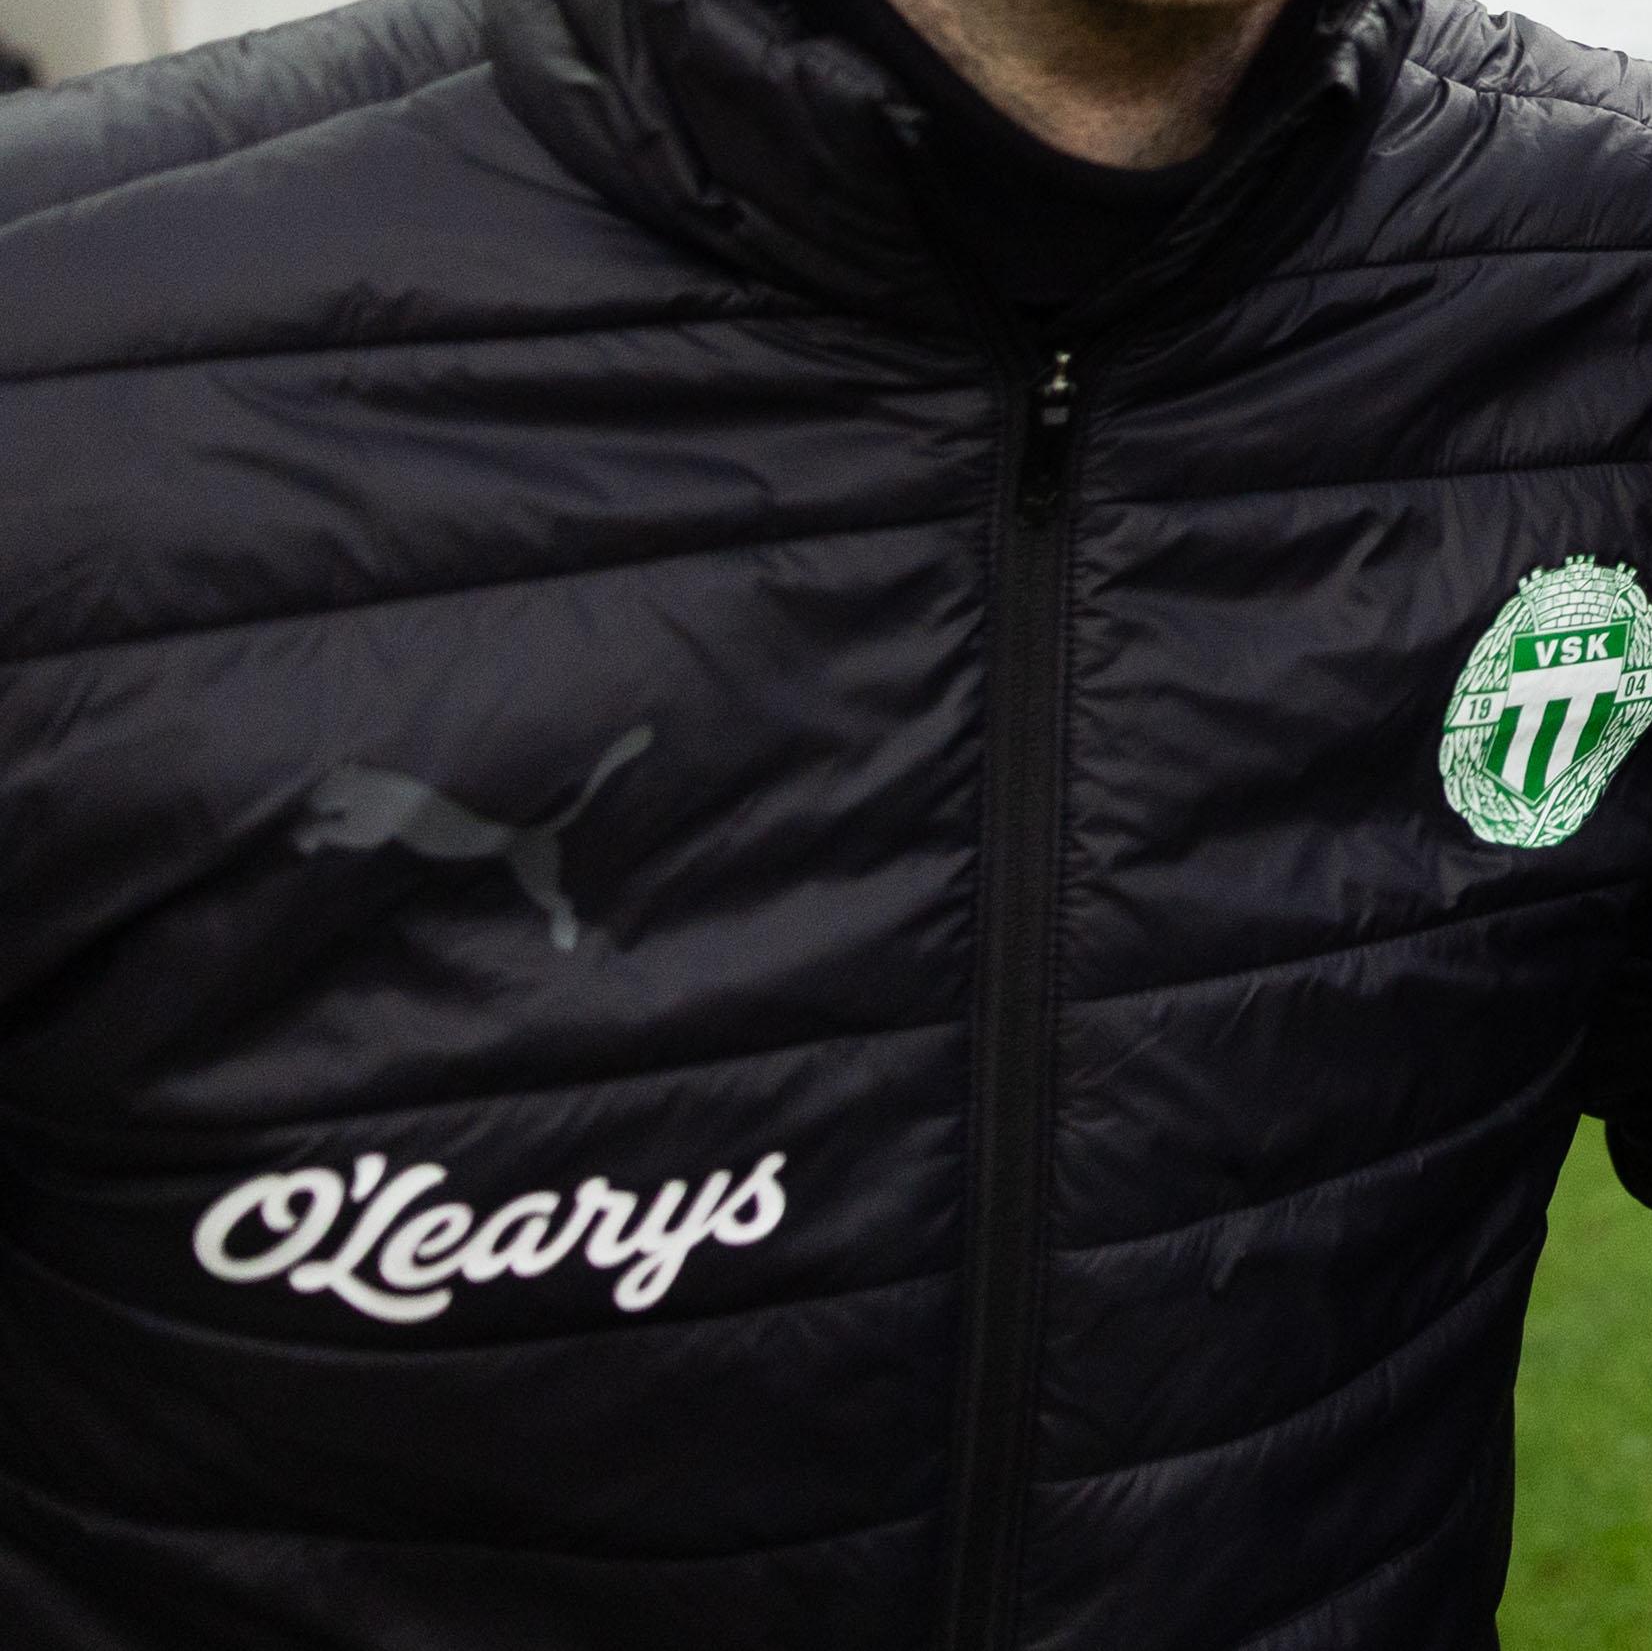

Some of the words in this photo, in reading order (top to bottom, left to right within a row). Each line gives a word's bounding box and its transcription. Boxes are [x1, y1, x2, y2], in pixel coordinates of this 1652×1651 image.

[1535, 632, 1612, 668] VSK
[1468, 698, 1492, 721] 19
[1624, 675, 1647, 697] 04
[192, 1152, 787, 1324] O'Learys
